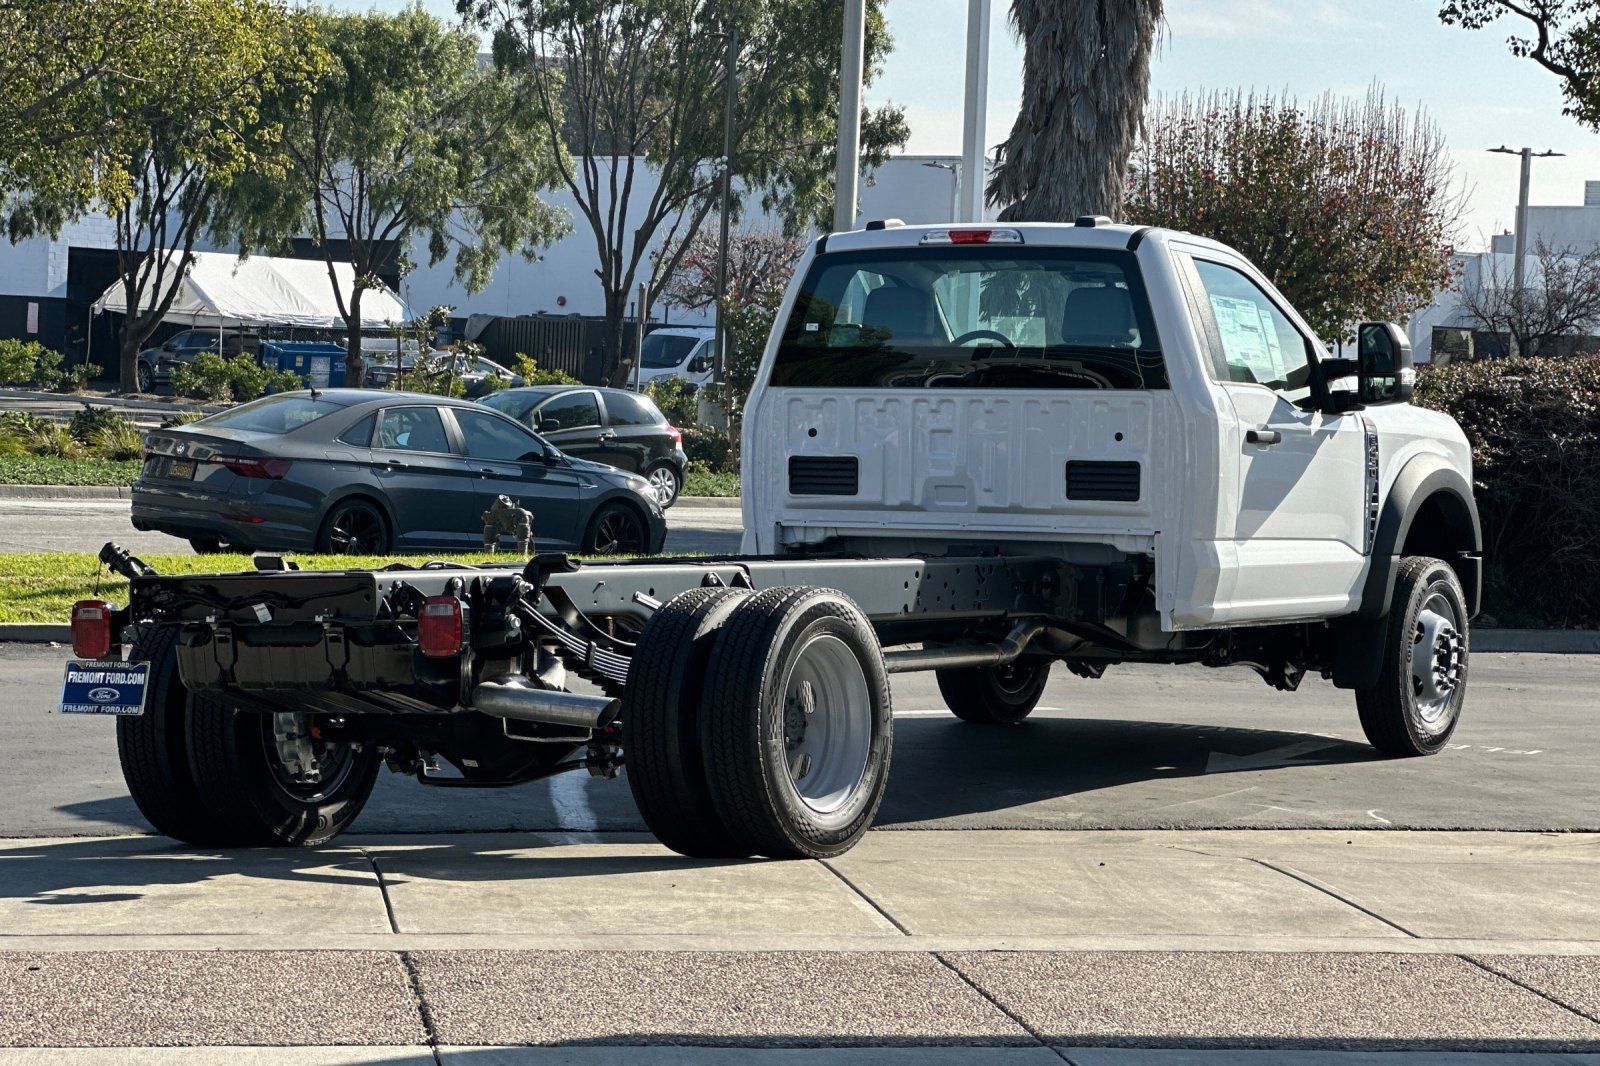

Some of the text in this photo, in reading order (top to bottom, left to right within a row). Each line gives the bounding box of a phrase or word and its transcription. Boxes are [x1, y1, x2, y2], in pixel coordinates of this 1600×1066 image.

[68, 671, 145, 685] FREMONT FORD.COM
[96, 690, 112, 699] Ford
[63, 704, 139, 714] FREMONT FORD.COM
